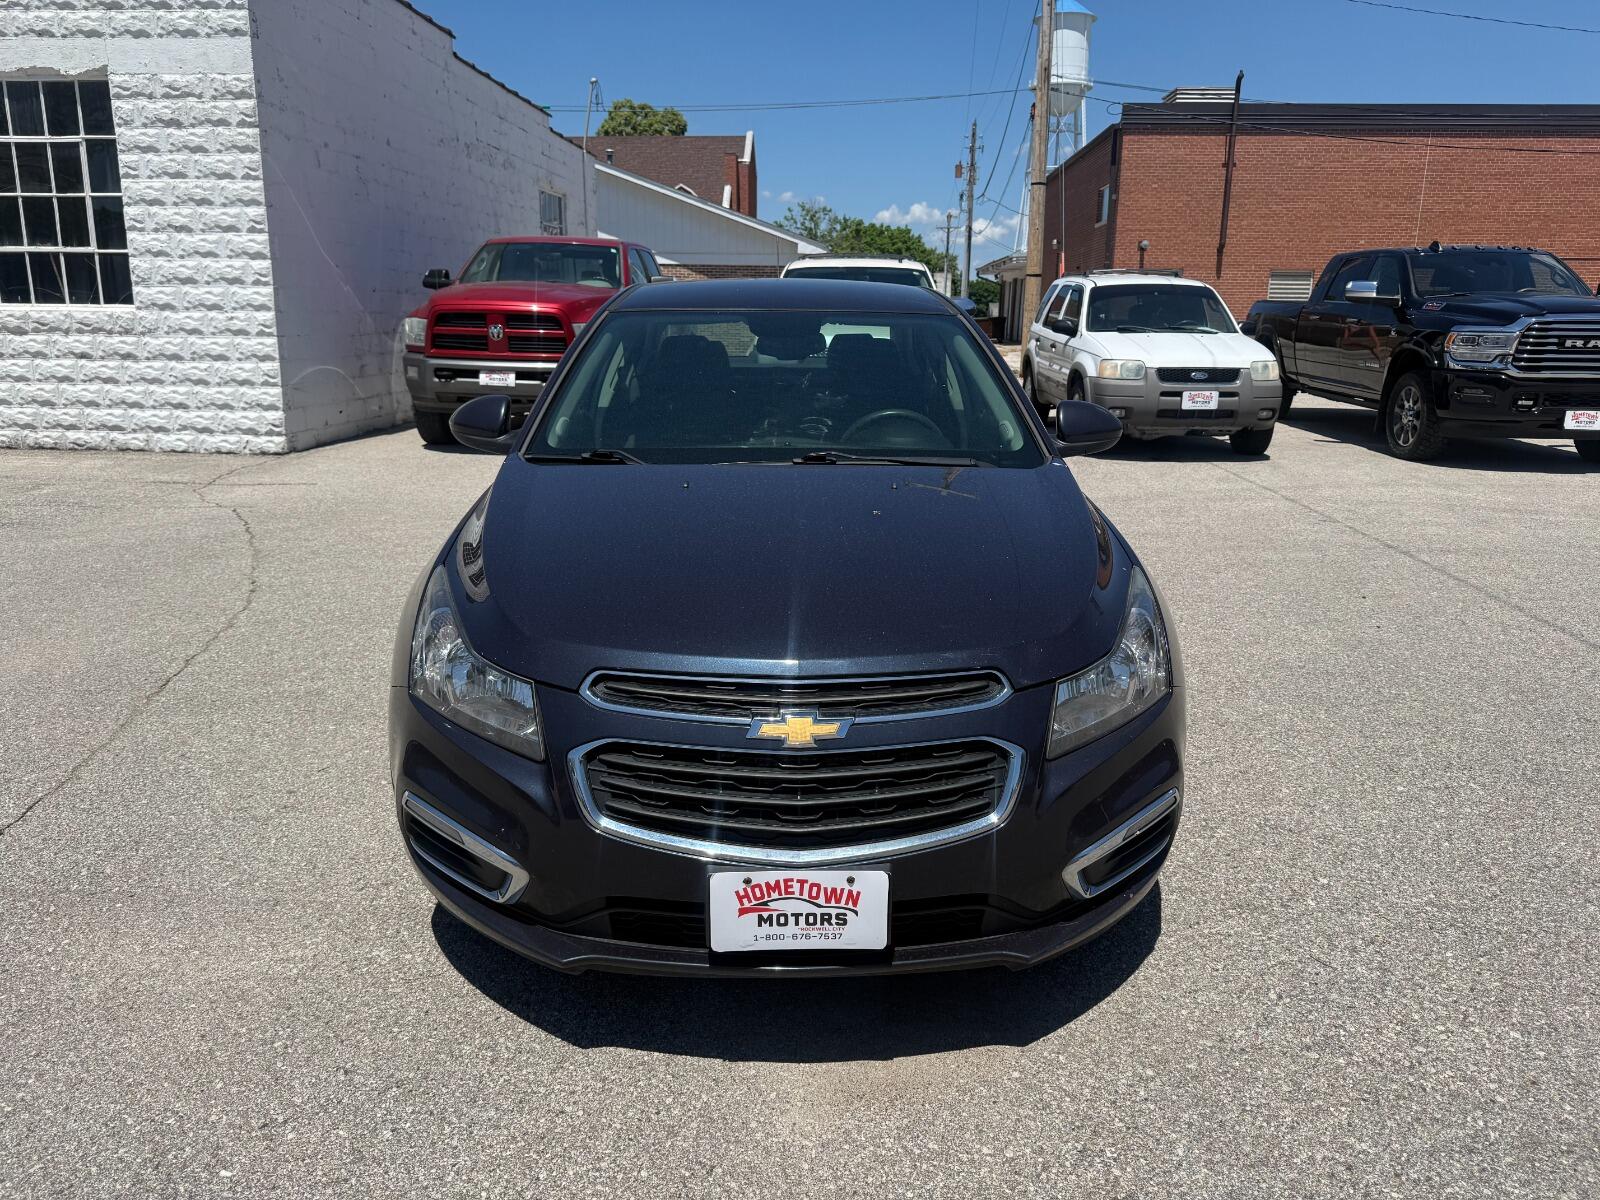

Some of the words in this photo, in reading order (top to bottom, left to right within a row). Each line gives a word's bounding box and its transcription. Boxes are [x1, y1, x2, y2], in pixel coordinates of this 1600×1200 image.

[735, 877, 861, 908] HOMETOWN
[757, 913, 848, 927] MOTORS
[753, 933, 843, 941] 1-800-676-7537
